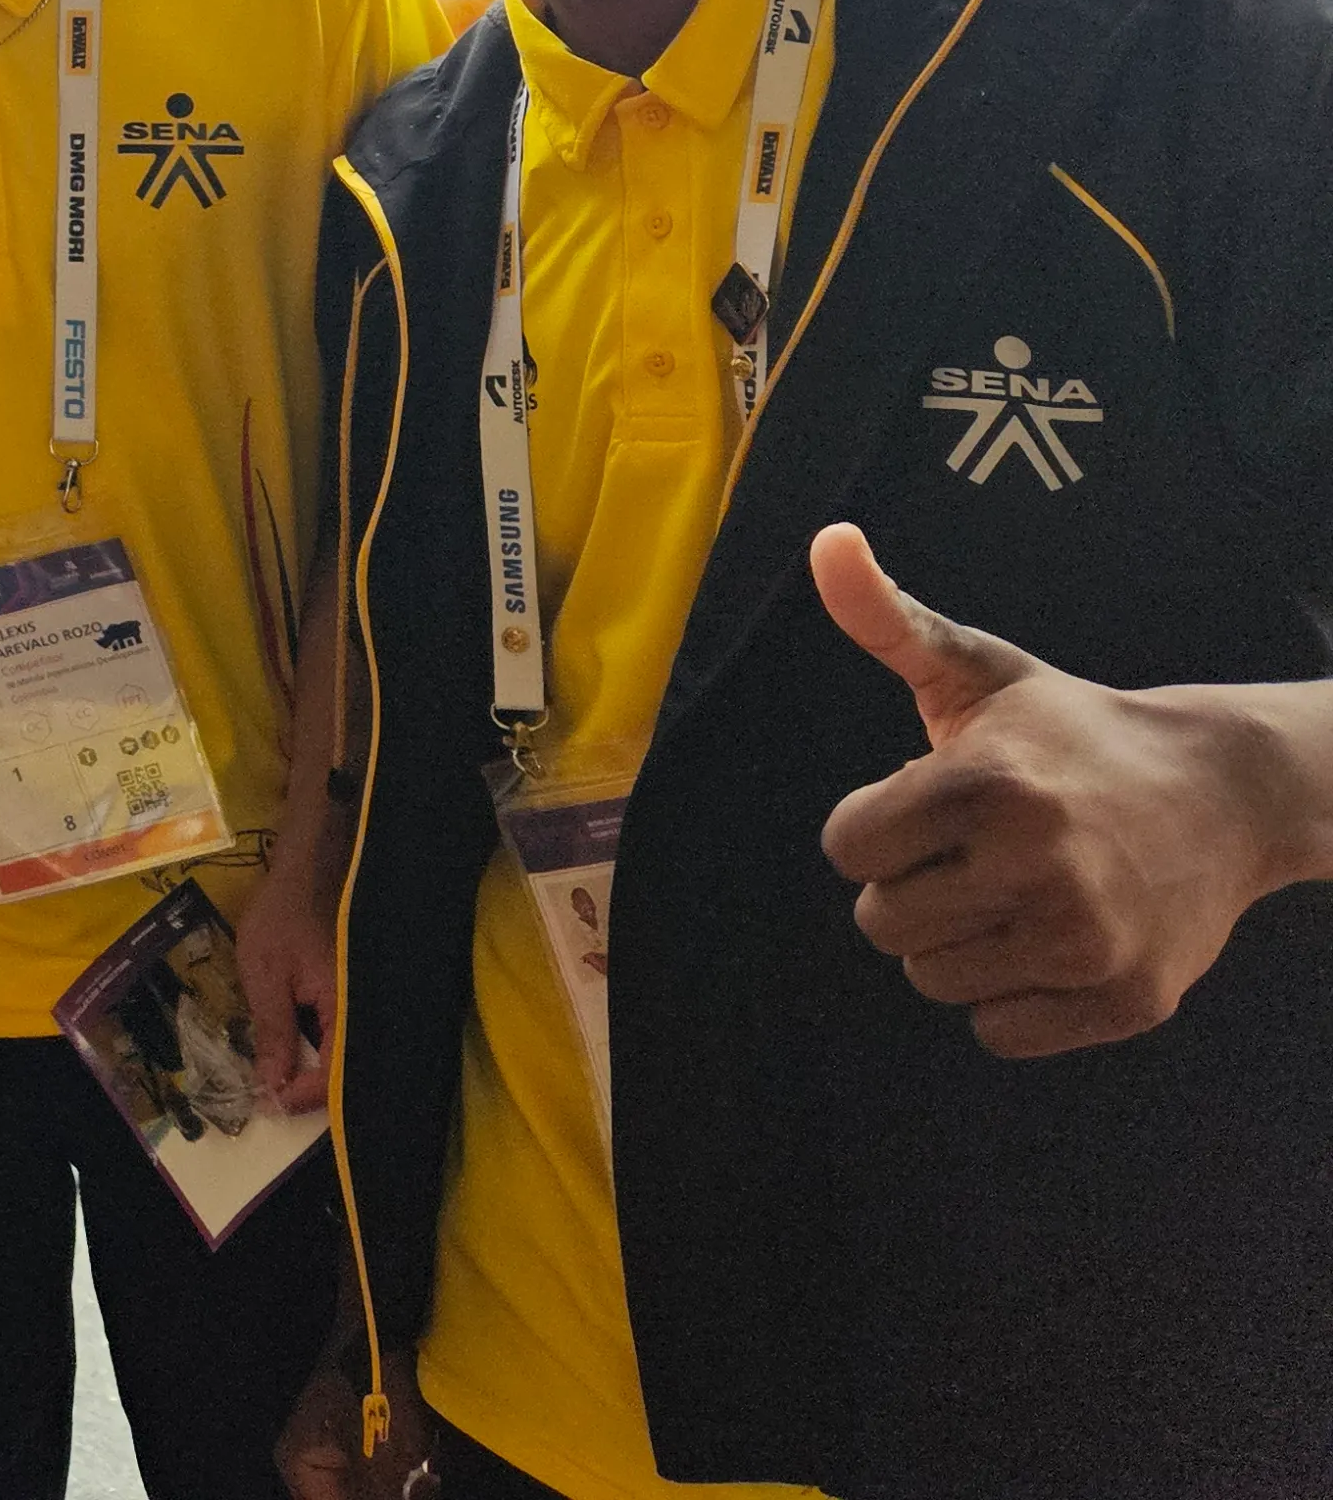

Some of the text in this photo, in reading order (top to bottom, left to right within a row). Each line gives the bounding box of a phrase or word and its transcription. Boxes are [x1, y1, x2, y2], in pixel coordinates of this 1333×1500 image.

[121, 121, 243, 141] SENA
[68, 133, 85, 263] DMG MORI
[64, 319, 86, 419] FESTO
[932, 365, 1100, 404] SENA
[512, 359, 524, 425] AUTODESK
[499, 488, 526, 614] SAMSUNG
[63, 621, 104, 642] ROZO
[12, 767, 23, 783] 1
[63, 815, 77, 832] 8
